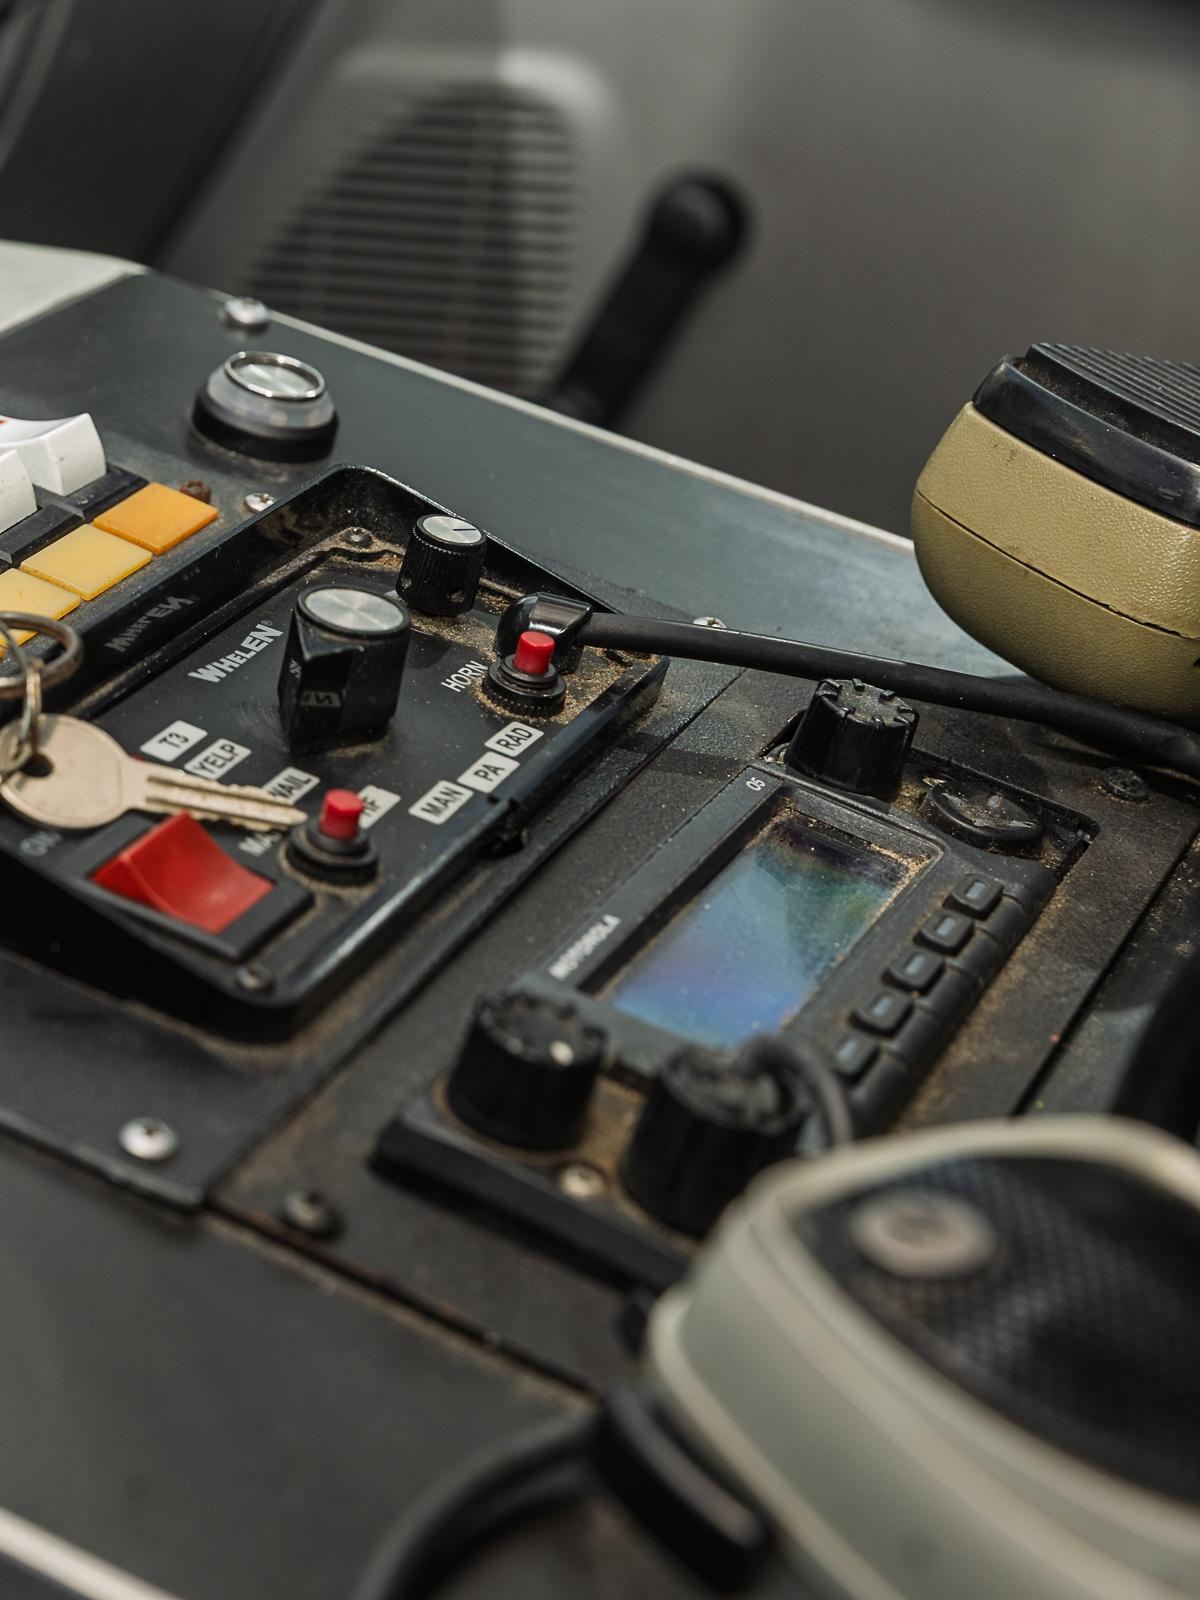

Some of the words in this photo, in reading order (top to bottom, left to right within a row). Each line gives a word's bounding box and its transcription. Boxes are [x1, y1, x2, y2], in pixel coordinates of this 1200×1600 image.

[187, 622, 284, 684] WHELEN
[440, 660, 489, 693] HORN
[158, 732, 190, 749] T3
[496, 727, 534, 751] RAD
[194, 743, 238, 776] YELP
[473, 763, 506, 783] PA
[420, 786, 465, 817] MAN
